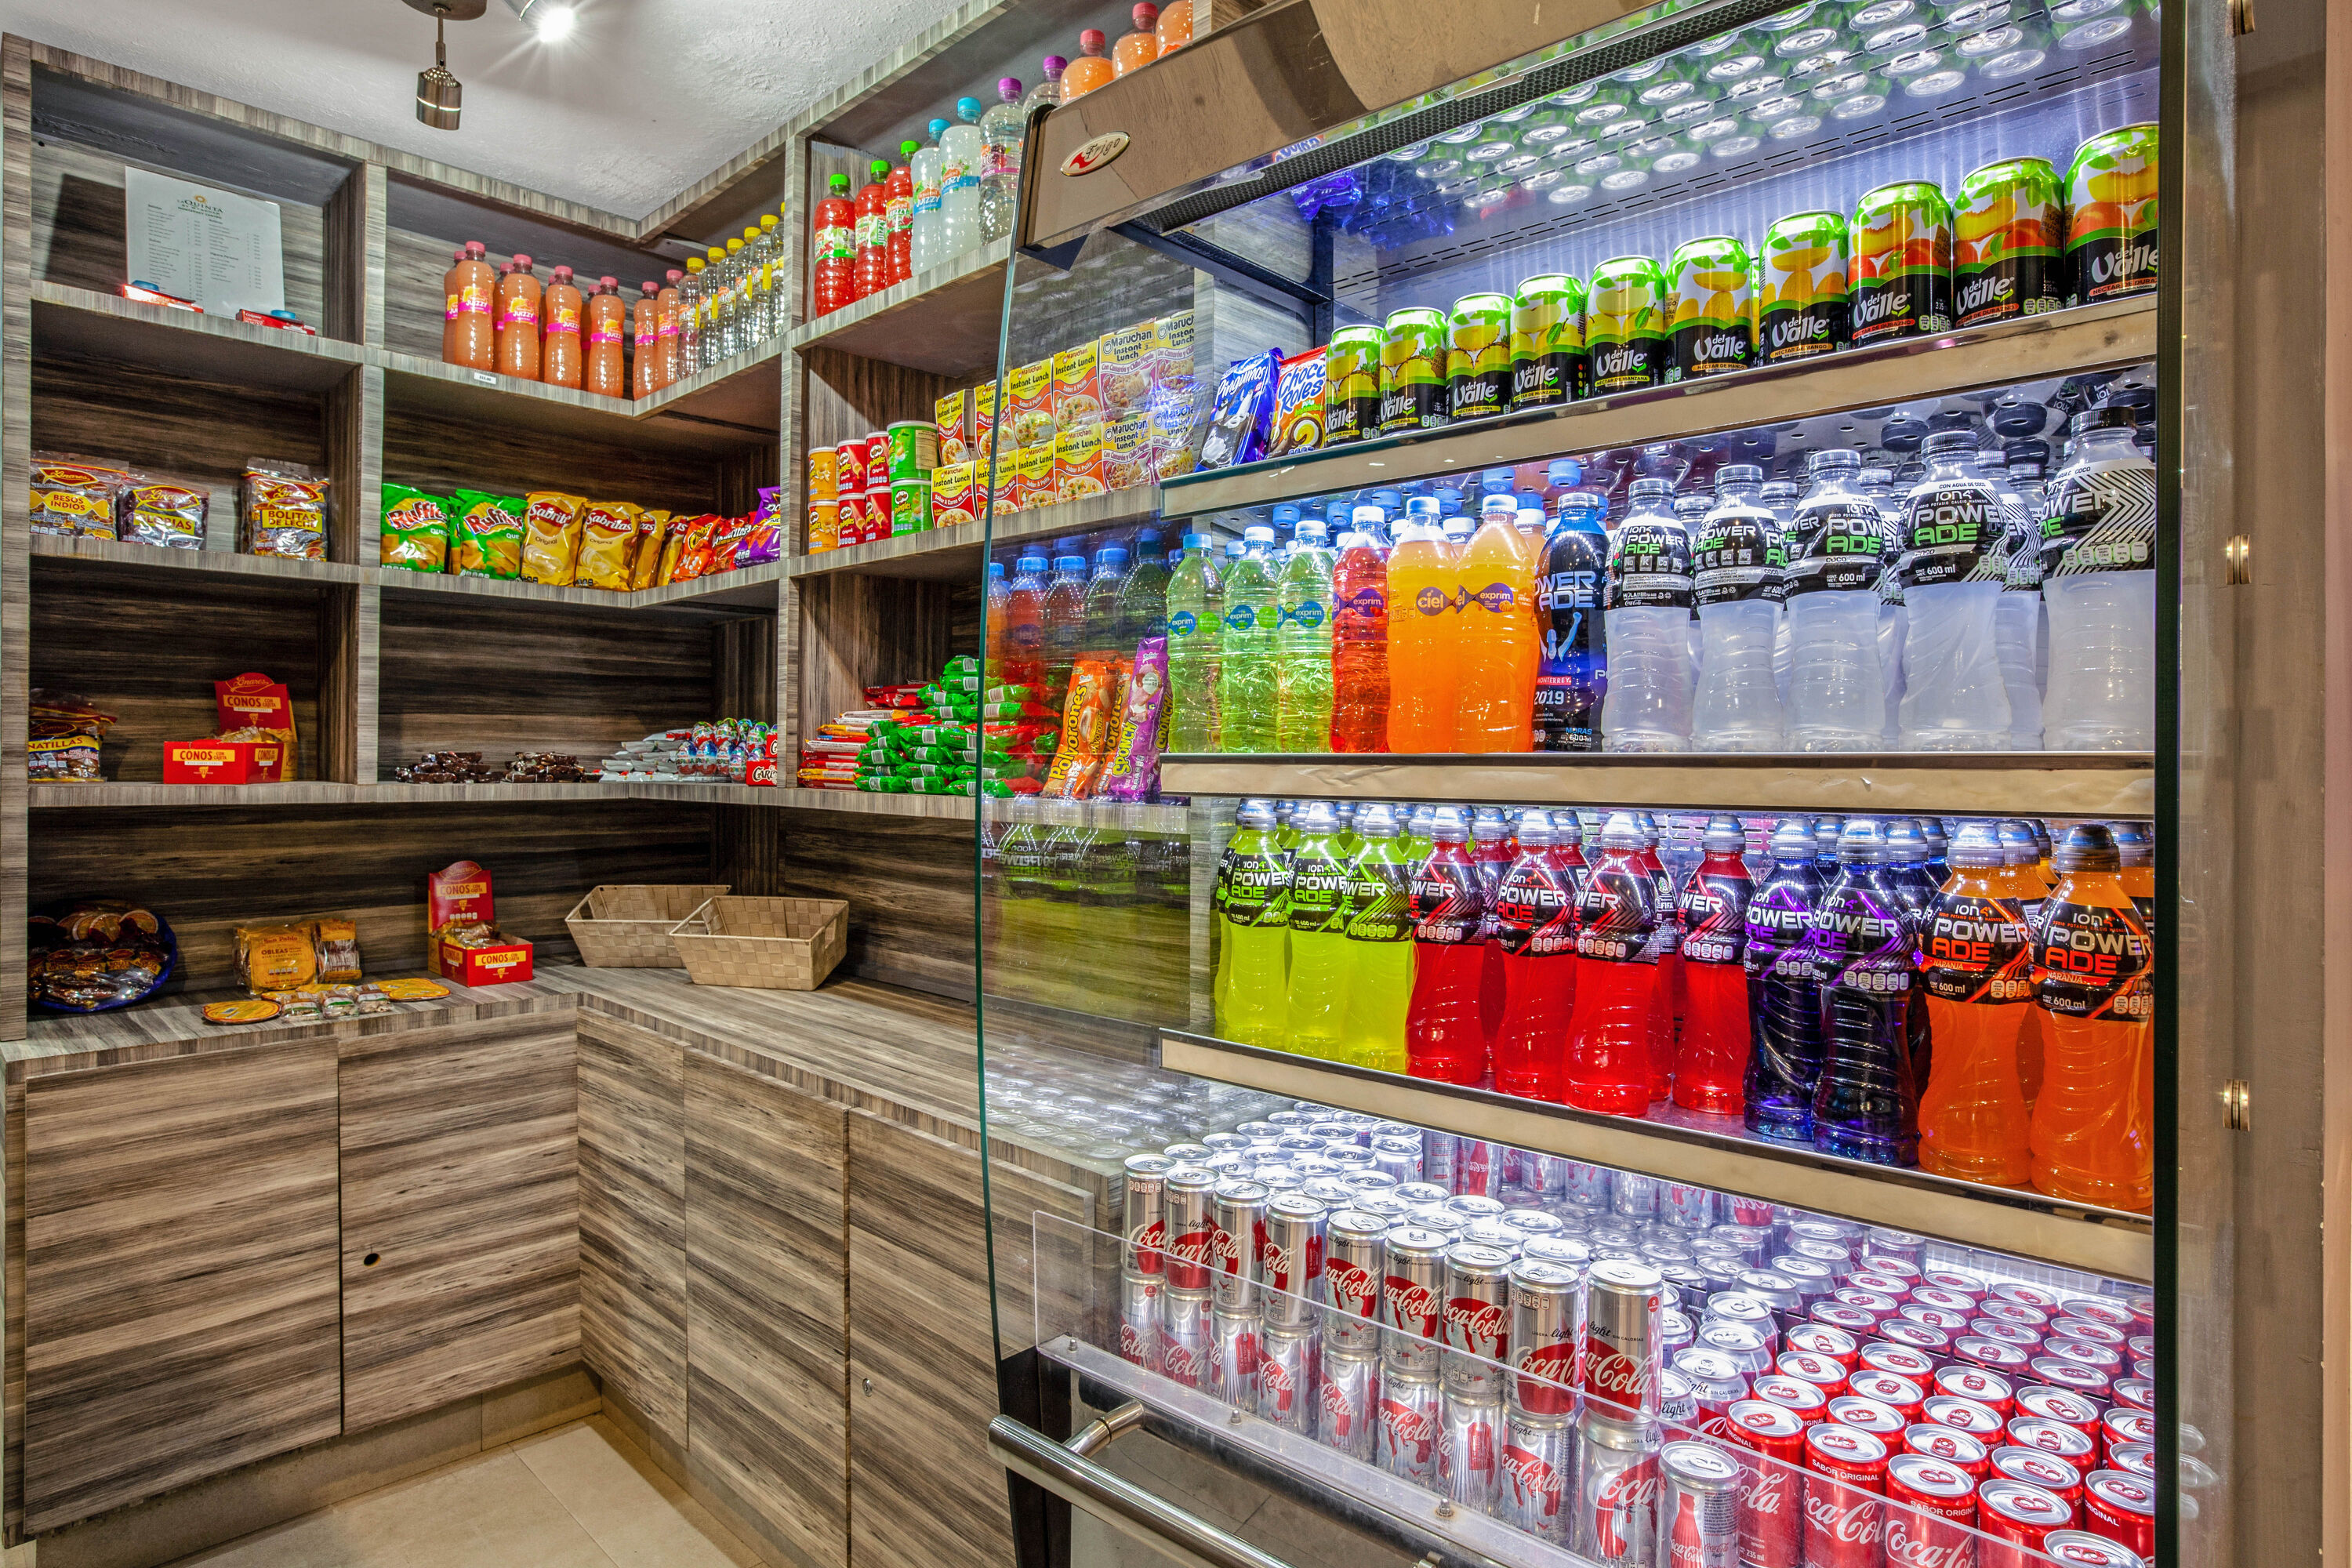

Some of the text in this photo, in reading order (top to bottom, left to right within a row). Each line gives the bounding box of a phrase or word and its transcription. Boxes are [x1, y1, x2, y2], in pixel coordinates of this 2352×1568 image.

[1086, 138, 1120, 159] Frigo
[184, 199, 223, 213] QUINTA
[916, 196, 941, 207] JUIZZY
[1111, 330, 1152, 346] Maruchan
[1067, 349, 1088, 359] Maruchan
[1114, 343, 1142, 355] Instant
[1116, 351, 1139, 362] Lunch
[1022, 365, 1042, 376] Maruchan
[1055, 355, 1094, 375] Instant Lunch
[1011, 372, 1049, 390] Instant Lunch
[1278, 363, 1326, 399] Choco
[977, 395, 994, 407] Instant
[1280, 379, 1324, 418] Roles
[937, 403, 962, 418] Instant Lunch
[1112, 419, 1149, 434] Maruchan
[1069, 430, 1092, 440] Maruchan
[1114, 431, 1138, 444] Instant
[1029, 446, 1048, 456] Maruchan
[1056, 438, 1102, 453] Instant Lunch
[1116, 439, 1136, 451] Lunch
[869, 456, 885, 467] Pringles
[1019, 458, 1038, 470] Instant
[944, 467, 964, 476] Maruchan
[1000, 463, 1016, 474] Lunch
[934, 474, 970, 488] Instant Lunch
[53, 494, 84, 503] BESOS
[50, 501, 85, 510] INDIOS
[895, 502, 911, 514] Pringles
[268, 510, 317, 521] BOLITAS
[586, 511, 633, 532] Sabritas
[1698, 525, 1756, 542] POWER
[1914, 524, 1980, 546] ADE
[535, 536, 557, 545] Original
[1627, 534, 1685, 546] POWER
[1696, 537, 1725, 552] ADE
[1827, 535, 1882, 554] ADE
[1625, 544, 1661, 554] ADE
[1708, 553, 1714, 562] K
[1722, 552, 1732, 561] Ca
[1740, 551, 1751, 561] Mg
[1927, 564, 1956, 575] 600 ml
[1838, 573, 1865, 582] 600 ml
[1417, 590, 1444, 609] ciel
[1479, 590, 1511, 601] exprim
[1539, 590, 1594, 611] ADE
[1353, 596, 1381, 608] exprim
[1229, 611, 1252, 620] exprim
[1295, 608, 1322, 617] exprim
[227, 696, 261, 707] CONOS
[1534, 691, 1564, 705] 2019
[1049, 685, 1087, 780] Polvorones
[1112, 720, 1138, 776] SPONCH
[180, 750, 212, 760] CONOS
[440, 884, 470, 895] CONOS
[1231, 886, 1267, 898] ADE
[1294, 890, 1334, 902] ADE
[1498, 887, 1567, 906] POWER
[1497, 902, 1535, 920] ADE
[1814, 909, 1899, 938] POWER
[1933, 918, 2029, 942] POWER
[2047, 927, 2152, 956] POWER
[1932, 938, 1994, 961] ADE
[481, 953, 508, 964] CONOS
[2045, 947, 2122, 975] ADE
[1933, 960, 1964, 970] NARANJA
[2047, 971, 2083, 983] NARANJA
[1939, 984, 1954, 993] 600
[2053, 997, 2085, 1009] 600 ml
[1189, 1218, 1210, 1229] light
[1334, 1237, 1350, 1248] light
[1393, 1254, 1410, 1265] light
[1464, 1275, 1483, 1286] light
[1552, 1328, 1573, 1343] light
[1589, 1321, 1611, 1338] light
[1388, 1379, 1405, 1390] light
[1661, 1401, 1686, 1420] light
[1513, 1424, 1532, 1436] light
[1812, 1459, 1879, 1482] SABOR ORIGINAL
[1910, 1501, 1976, 1516] SABOR ORIGINA
[1747, 1549, 1757, 1558] 235
